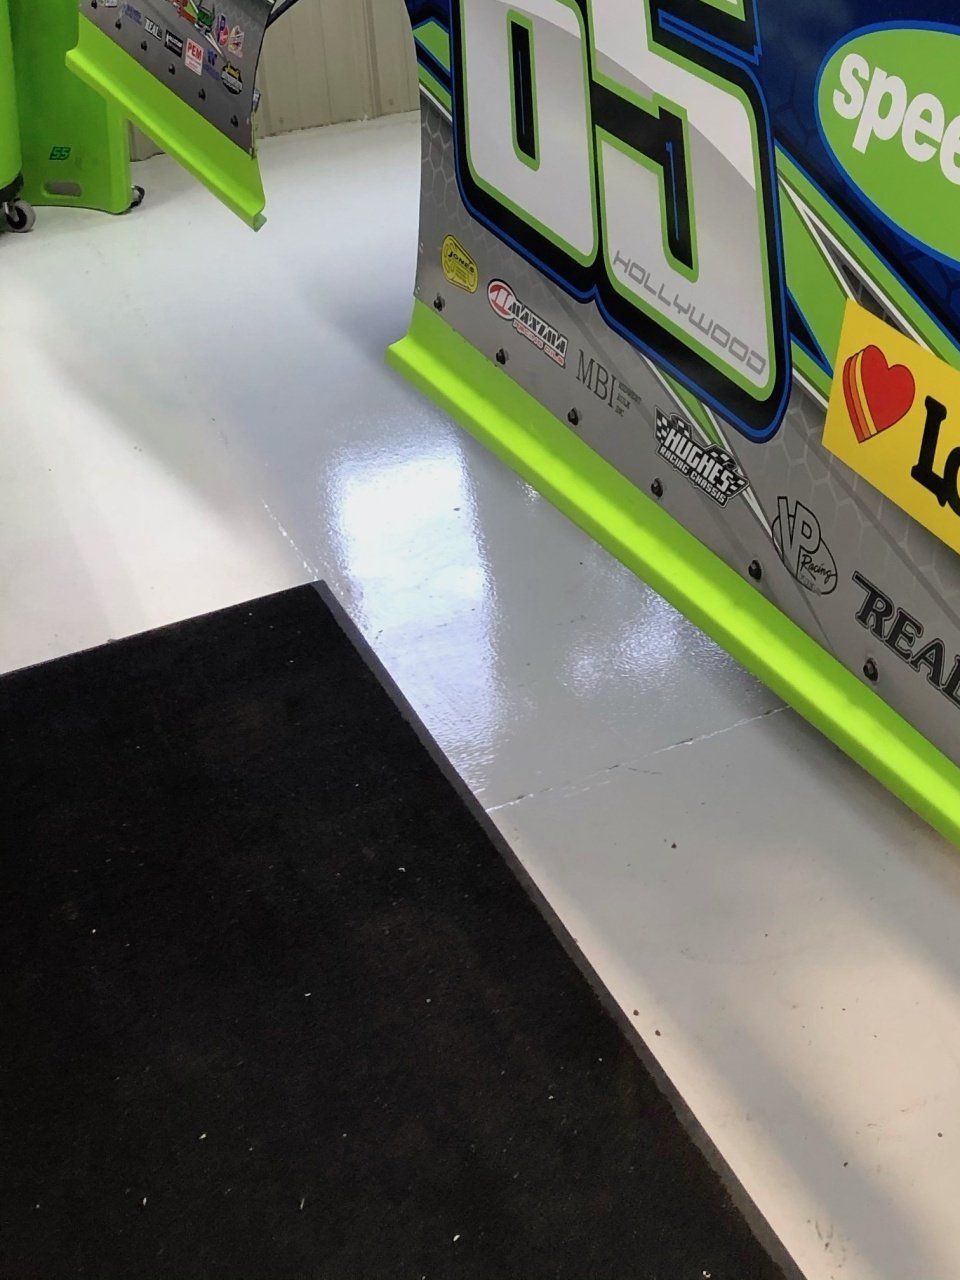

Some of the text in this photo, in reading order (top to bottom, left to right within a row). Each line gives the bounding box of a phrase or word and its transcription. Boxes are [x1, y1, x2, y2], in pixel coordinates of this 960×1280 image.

[507, 300, 567, 355] MAXIMA
[612, 249, 767, 376] HOLLYWOOD
[575, 348, 617, 409] MBI
[659, 445, 728, 504] RACING CHASSIS
[663, 427, 735, 493] HUGHES
[776, 495, 822, 578] VP
[799, 553, 834, 584] Racing
